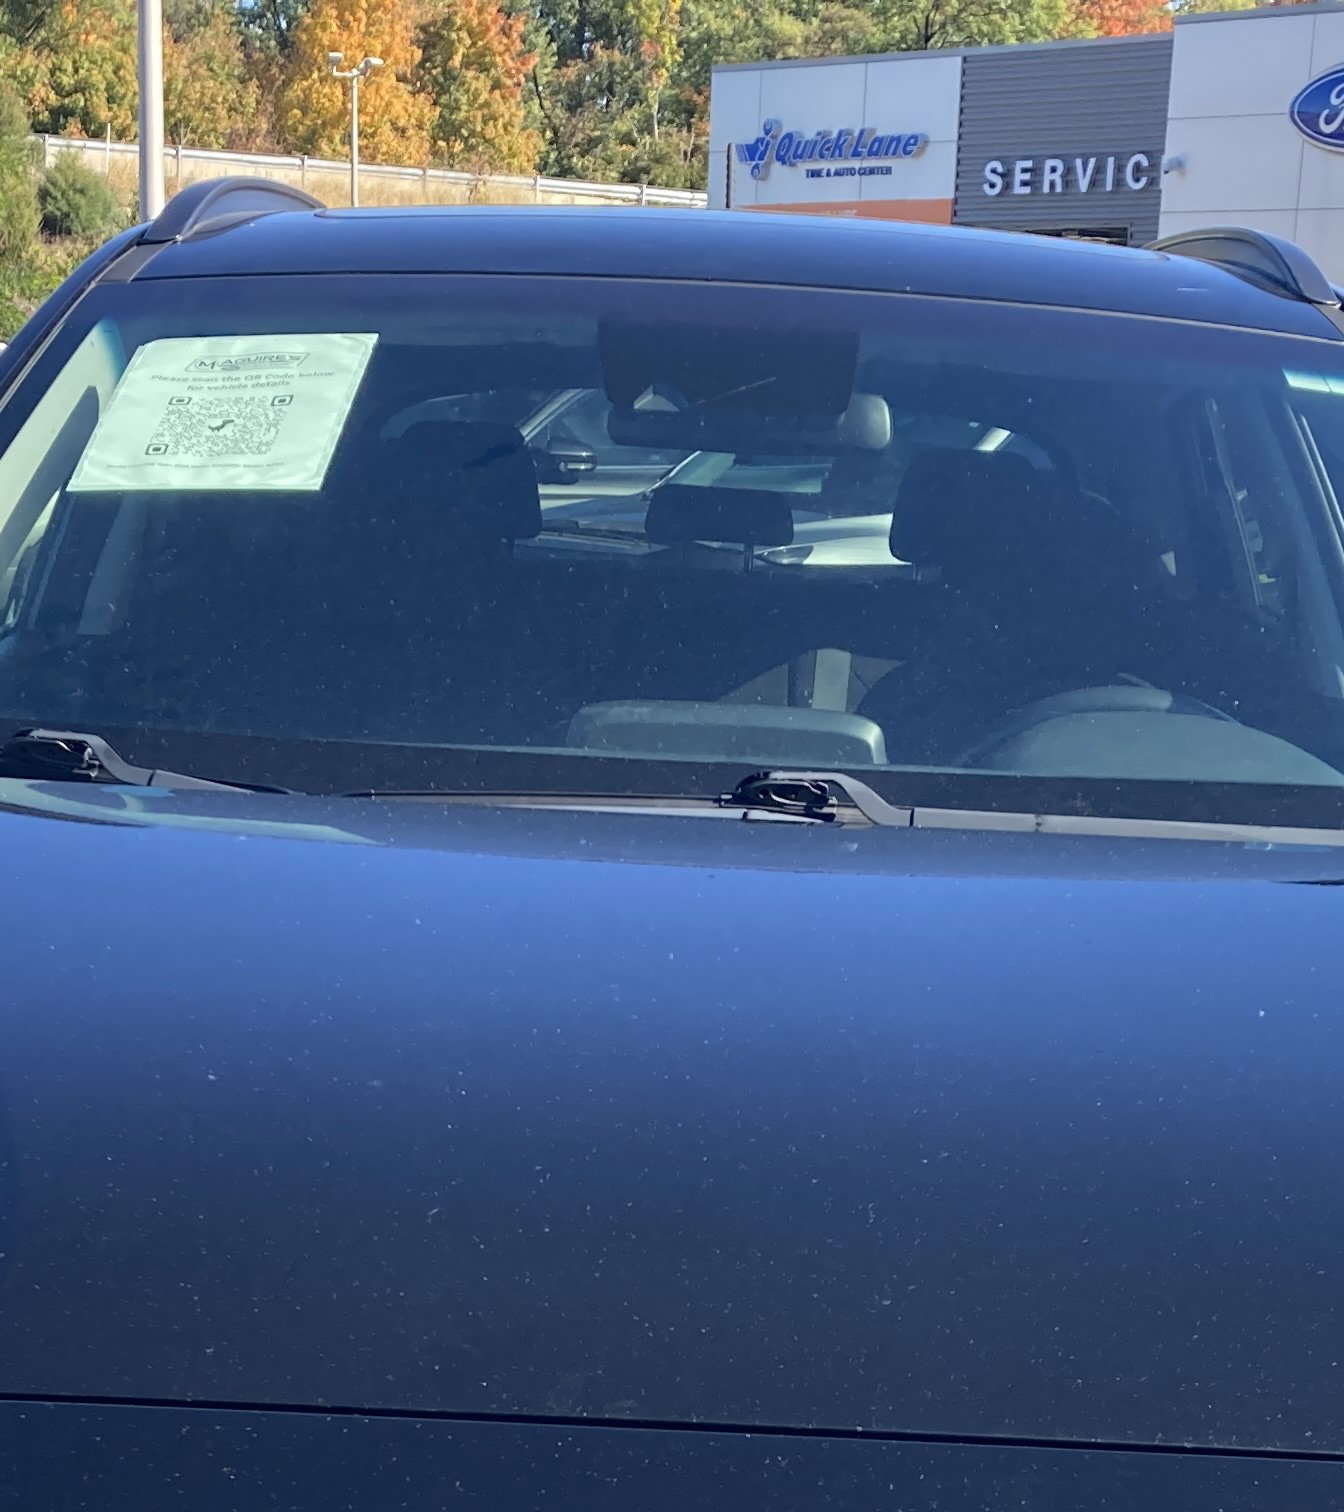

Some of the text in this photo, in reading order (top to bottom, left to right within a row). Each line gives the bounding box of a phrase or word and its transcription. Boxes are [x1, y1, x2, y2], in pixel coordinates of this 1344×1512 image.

[775, 128, 919, 166] Quick Lane
[982, 153, 1149, 196] SERVIC
